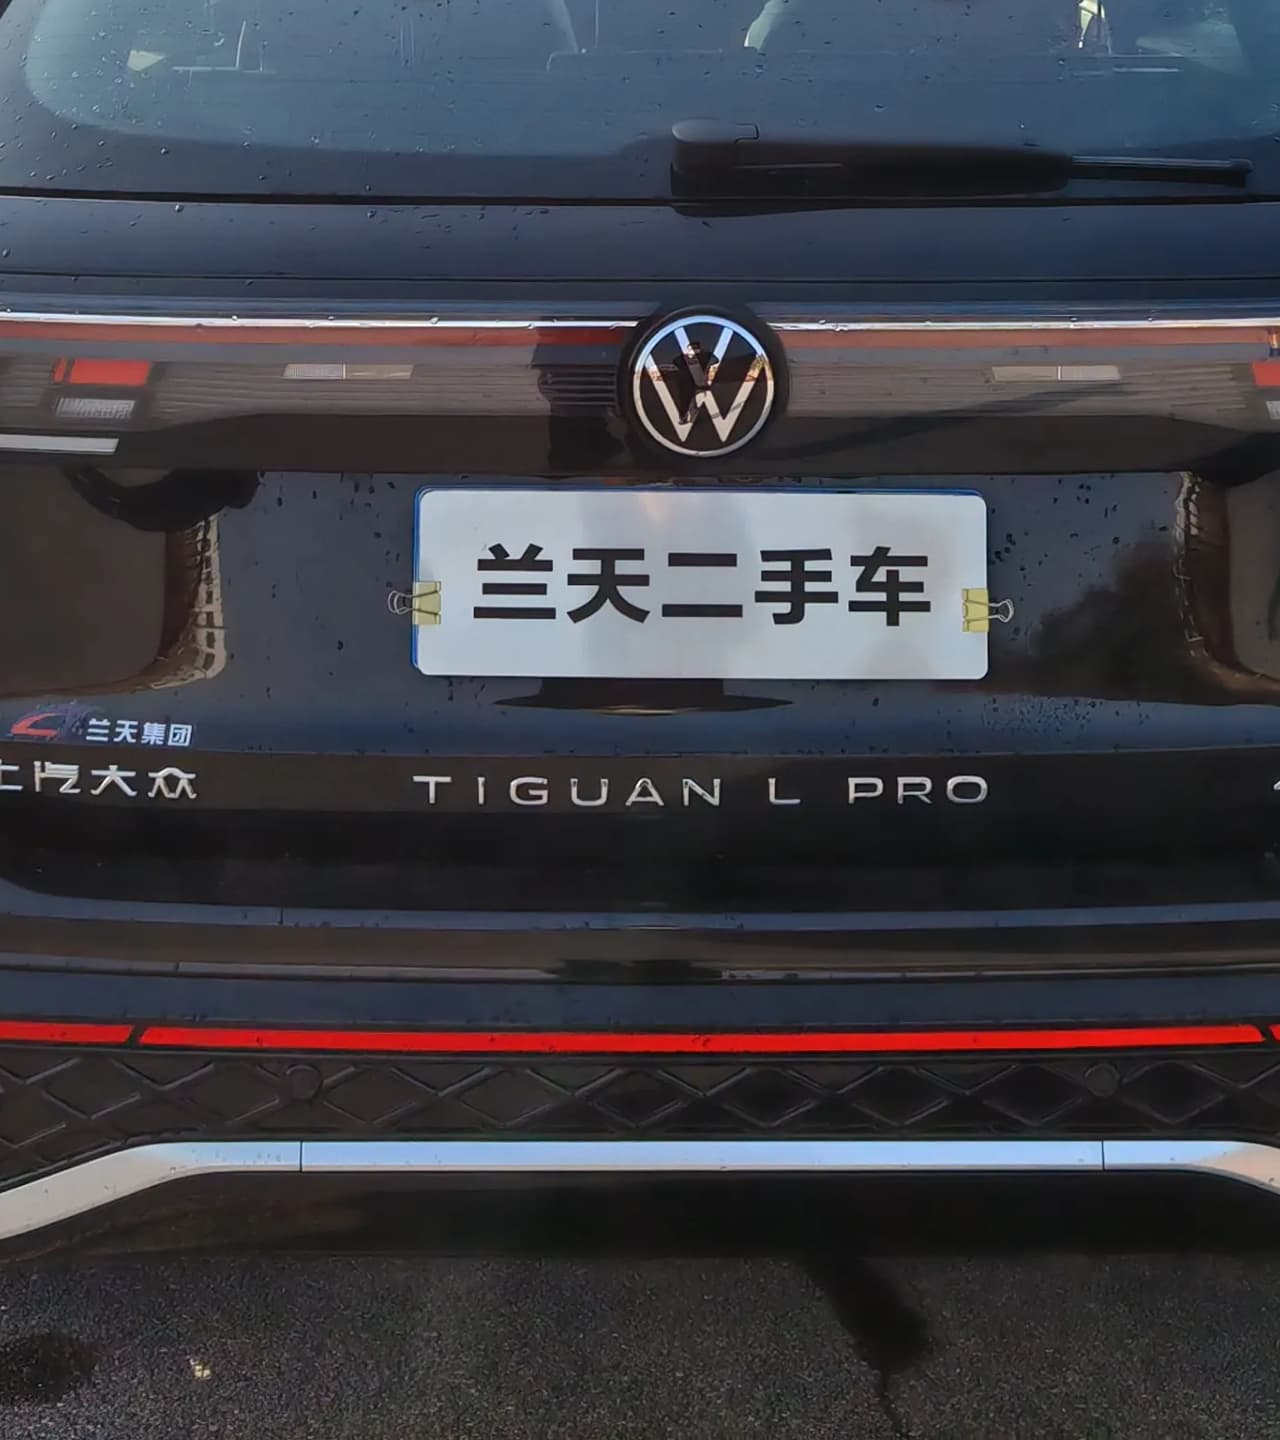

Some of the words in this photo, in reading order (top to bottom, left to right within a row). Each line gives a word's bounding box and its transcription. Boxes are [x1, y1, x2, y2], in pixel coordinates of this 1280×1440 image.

[473, 542, 932, 627] 兰天二手车
[85, 717, 194, 747] 兰天集团
[412, 774, 722, 807] TIGUAN
[768, 777, 801, 805] L
[847, 774, 989, 806] PRO
